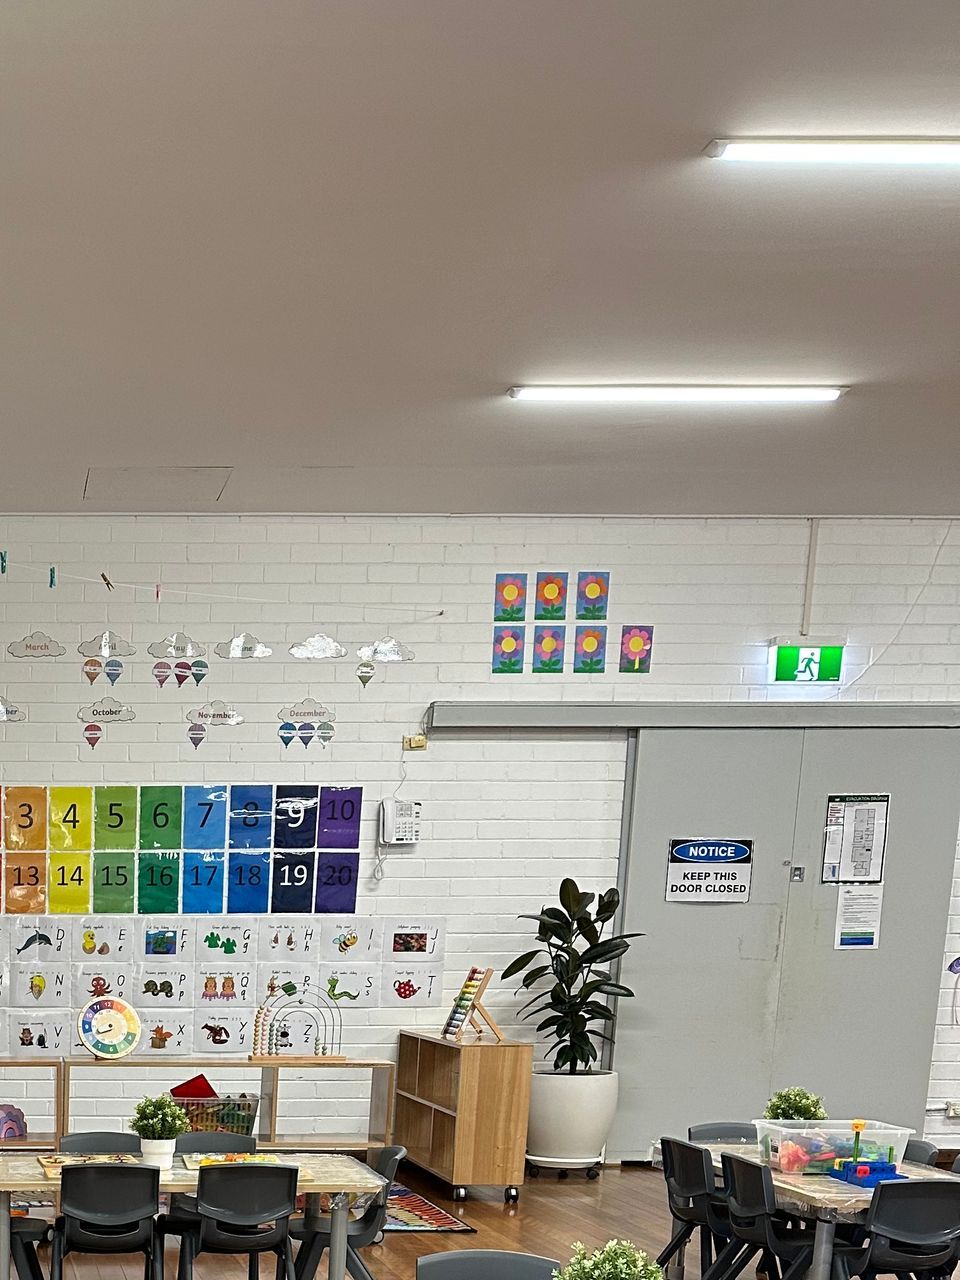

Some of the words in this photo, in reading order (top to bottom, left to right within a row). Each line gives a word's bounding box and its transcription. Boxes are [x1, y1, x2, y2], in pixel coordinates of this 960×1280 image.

[25, 643, 49, 651] March
[92, 707, 122, 717] October
[289, 709, 326, 717] December
[18, 803, 34, 829] 3
[62, 803, 80, 829] 4
[107, 803, 124, 829] 5
[152, 802, 170, 828] 6
[197, 802, 214, 828] 7
[242, 801, 260, 827] 8
[287, 801, 305, 828] 9
[326, 799, 355, 821] 10
[688, 846, 736, 857] NOTICE
[13, 865, 40, 887] 13
[57, 865, 84, 886] 14
[101, 865, 128, 886] 15
[146, 865, 174, 886] 16
[190, 865, 218, 886] 17
[234, 865, 261, 886] 18
[279, 865, 308, 886] 19
[323, 865, 353, 886] 20
[682, 872, 711, 881] KEEP
[713, 872, 737, 881] THIS
[670, 884, 702, 893] DOOR
[705, 884, 747, 893] CLOSED
[56, 928, 65, 940] D
[119, 929, 126, 940] E
[181, 929, 188, 940] F
[242, 929, 251, 940] G
[304, 929, 313, 940] H
[431, 929, 438, 940] J
[55, 974, 64, 986] N
[117, 975, 125, 987] O
[179, 975, 186, 986] P
[241, 976, 249, 987] Q
[365, 977, 373, 988] S
[428, 976, 436, 986] T
[54, 1026, 62, 1037] V
[177, 1024, 185, 1035] X
[239, 1022, 248, 1032] Y
[304, 1025, 312, 1035] Z
